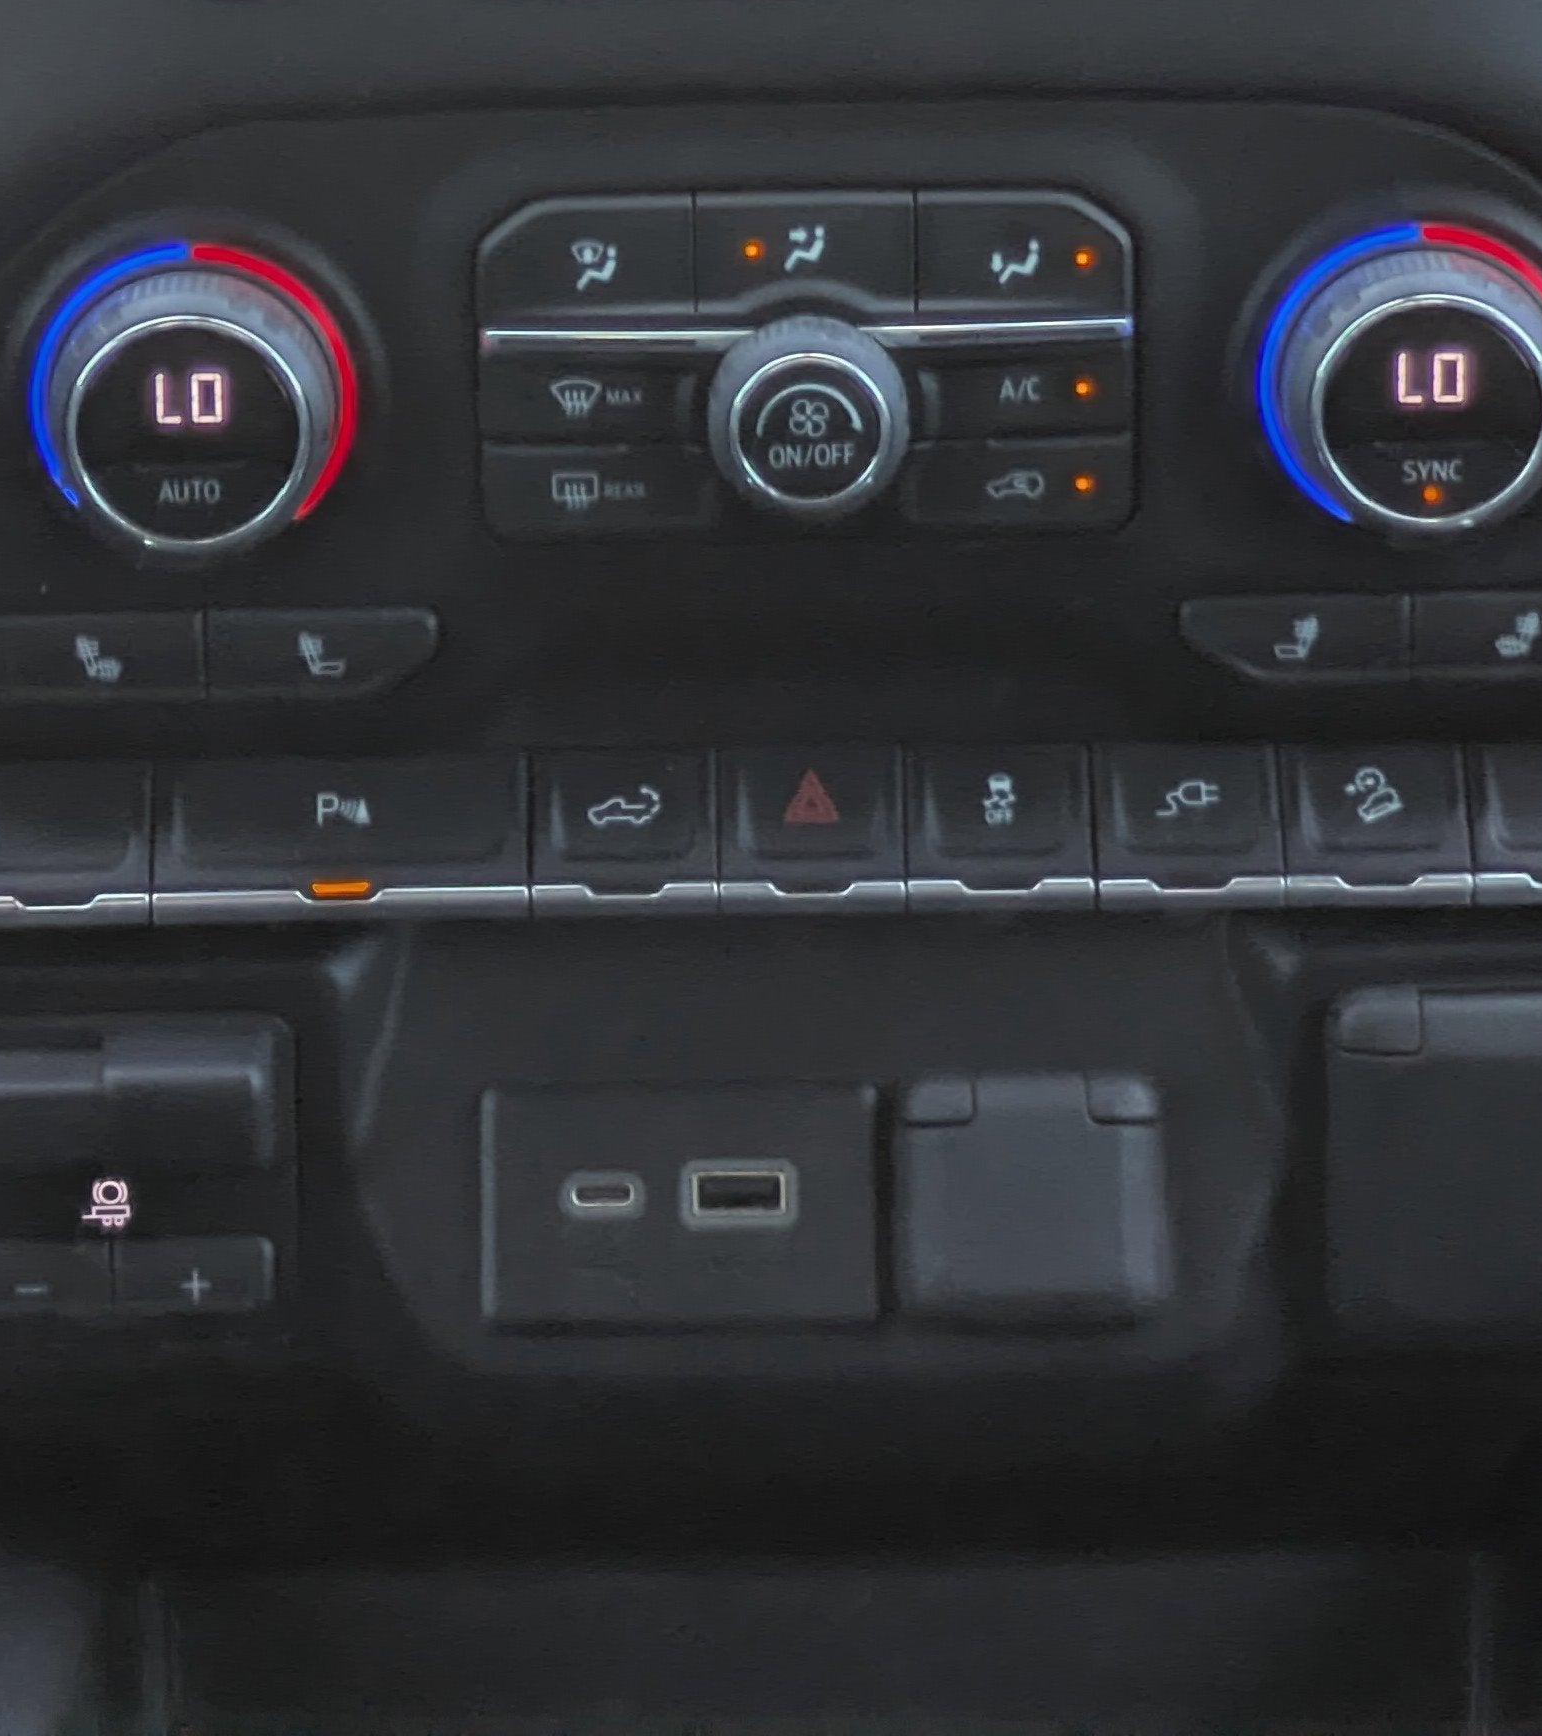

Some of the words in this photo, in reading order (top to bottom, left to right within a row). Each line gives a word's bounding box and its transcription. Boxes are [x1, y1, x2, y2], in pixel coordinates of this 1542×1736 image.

[999, 375, 1041, 401] A/C
[1396, 352, 1468, 405] LO
[154, 371, 224, 426] LO
[604, 388, 643, 406] MAX
[768, 442, 856, 470] ON/OFF
[1402, 459, 1463, 484] SYNC
[158, 478, 221, 505] AUTO
